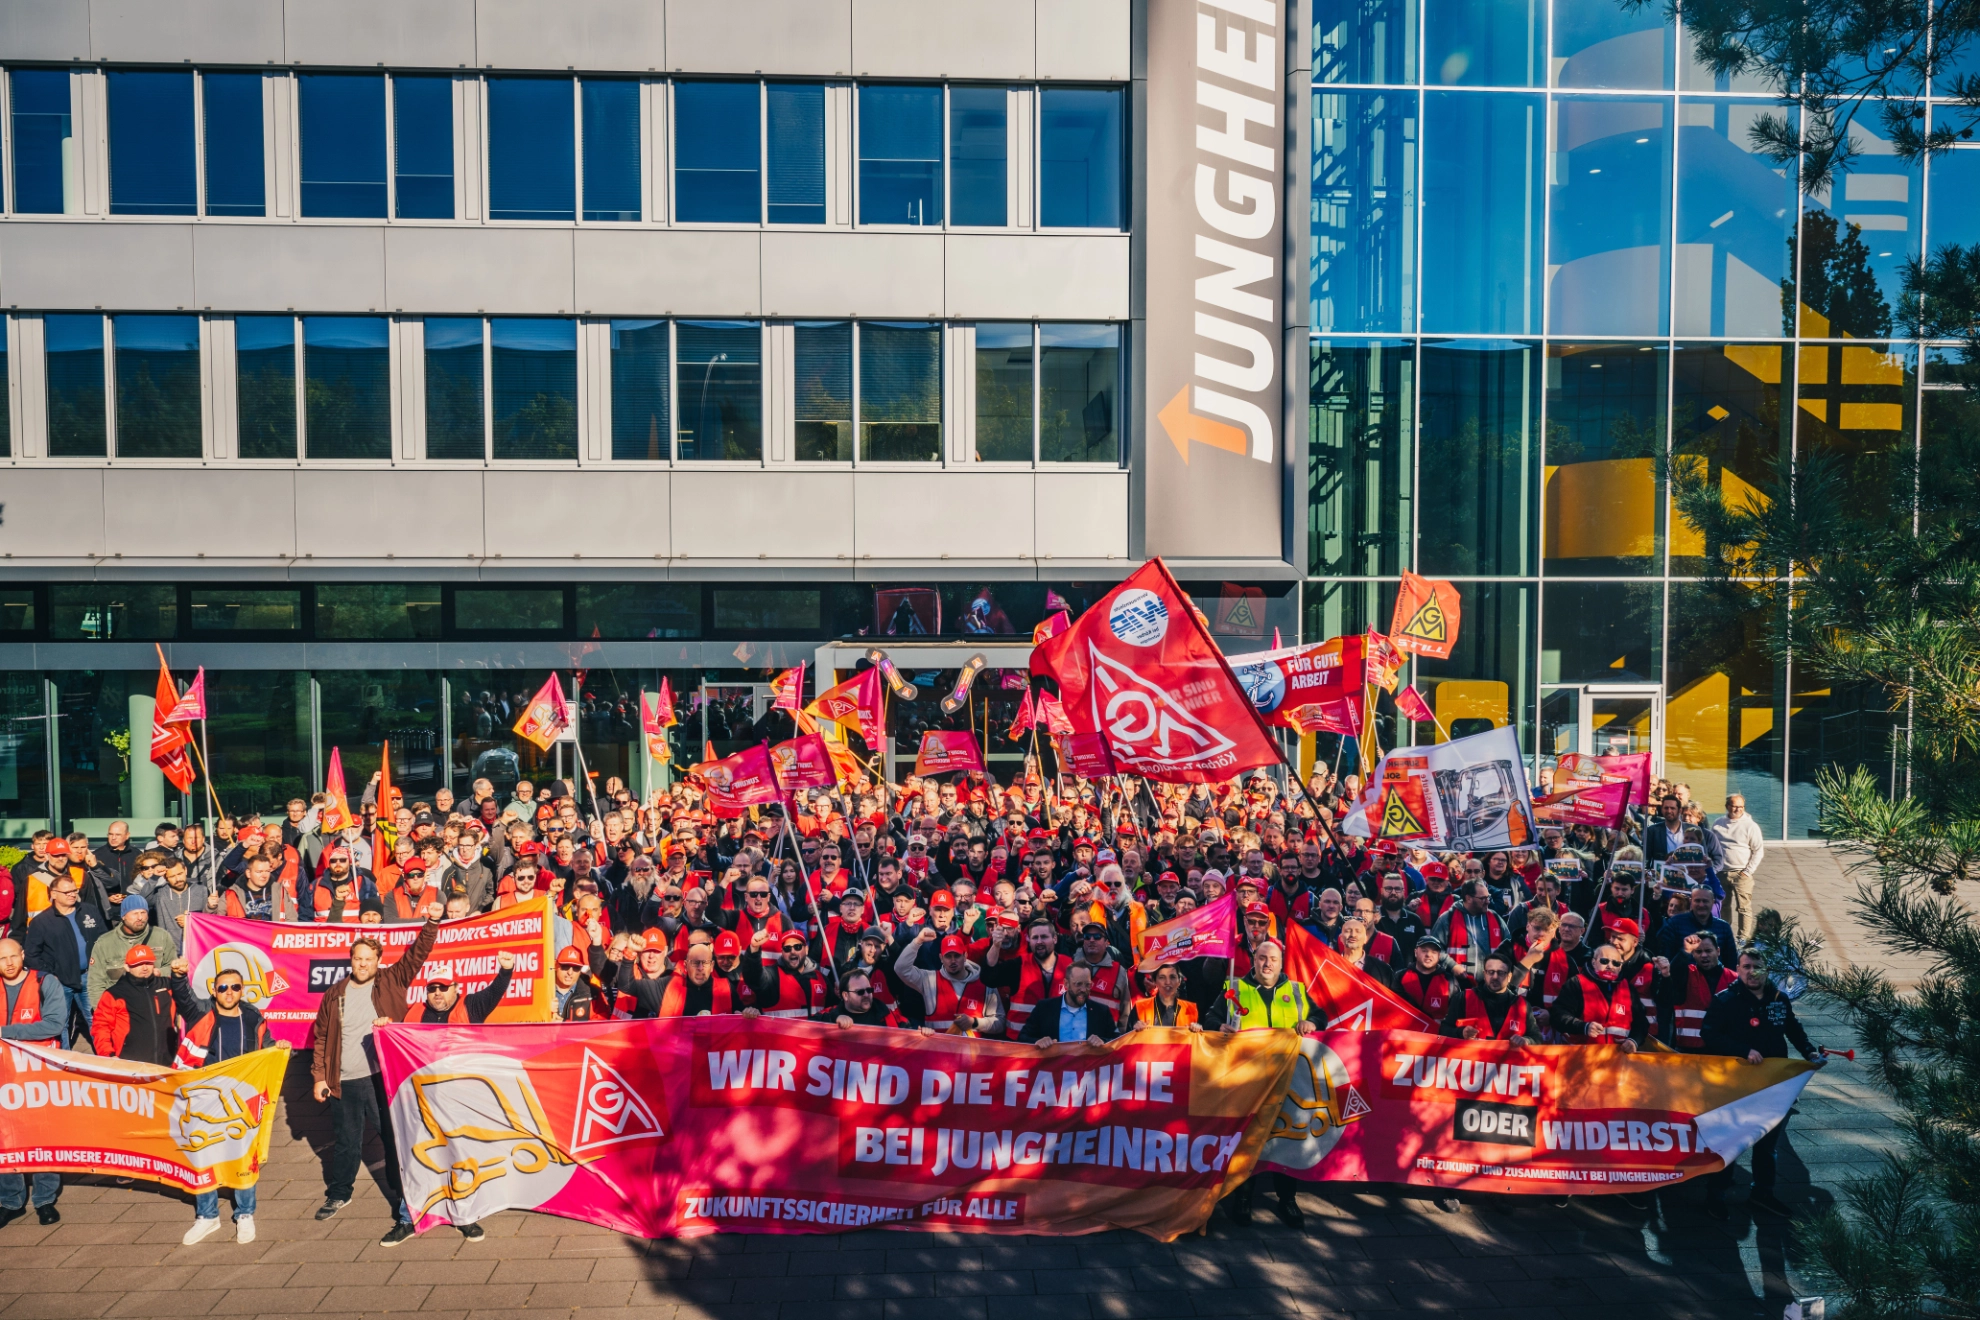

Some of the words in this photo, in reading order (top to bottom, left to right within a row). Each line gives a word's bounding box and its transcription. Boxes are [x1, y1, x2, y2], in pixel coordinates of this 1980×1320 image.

[1397, 638, 1446, 655] STILL
[1286, 654, 1312, 674] FÜR
[1313, 651, 1340, 670] GUTE
[1291, 670, 1330, 690] ARBEIT
[436, 925, 488, 944] ANDORTE
[263, 1011, 287, 1020] PARTS
[287, 1012, 318, 1020] KALTENK
[707, 1049, 797, 1092] WIR
[805, 1055, 910, 1105] SIND
[921, 1068, 994, 1106] DIE
[1003, 1061, 1175, 1109] FAMILIE
[1392, 1053, 1545, 1097] ZUKUNFT
[1462, 1108, 1529, 1138] ODER
[855, 1126, 925, 1165] BEI
[931, 1126, 1242, 1176] JUNGHEINRICH
[27, 1148, 53, 1162] FÜR
[55, 1151, 102, 1163] UNSERE
[103, 1152, 151, 1169] ZUKUNFT
[153, 1158, 173, 1174] UND
[173, 1166, 212, 1186] FAMILIE
[1416, 1157, 1434, 1168] FÜR
[1436, 1160, 1480, 1173] ZUKUNFT
[1482, 1165, 1503, 1176] UND
[1505, 1167, 1588, 1181] ZUSAMMENHALT
[1590, 1171, 1606, 1181] BEI
[1608, 1171, 1684, 1183] JUNGHEINRICH
[683, 1197, 914, 1226] ZUKUNFTSSICHERHEIT
[921, 1197, 962, 1216] FÜR
[965, 1198, 1018, 1220] ALLE
